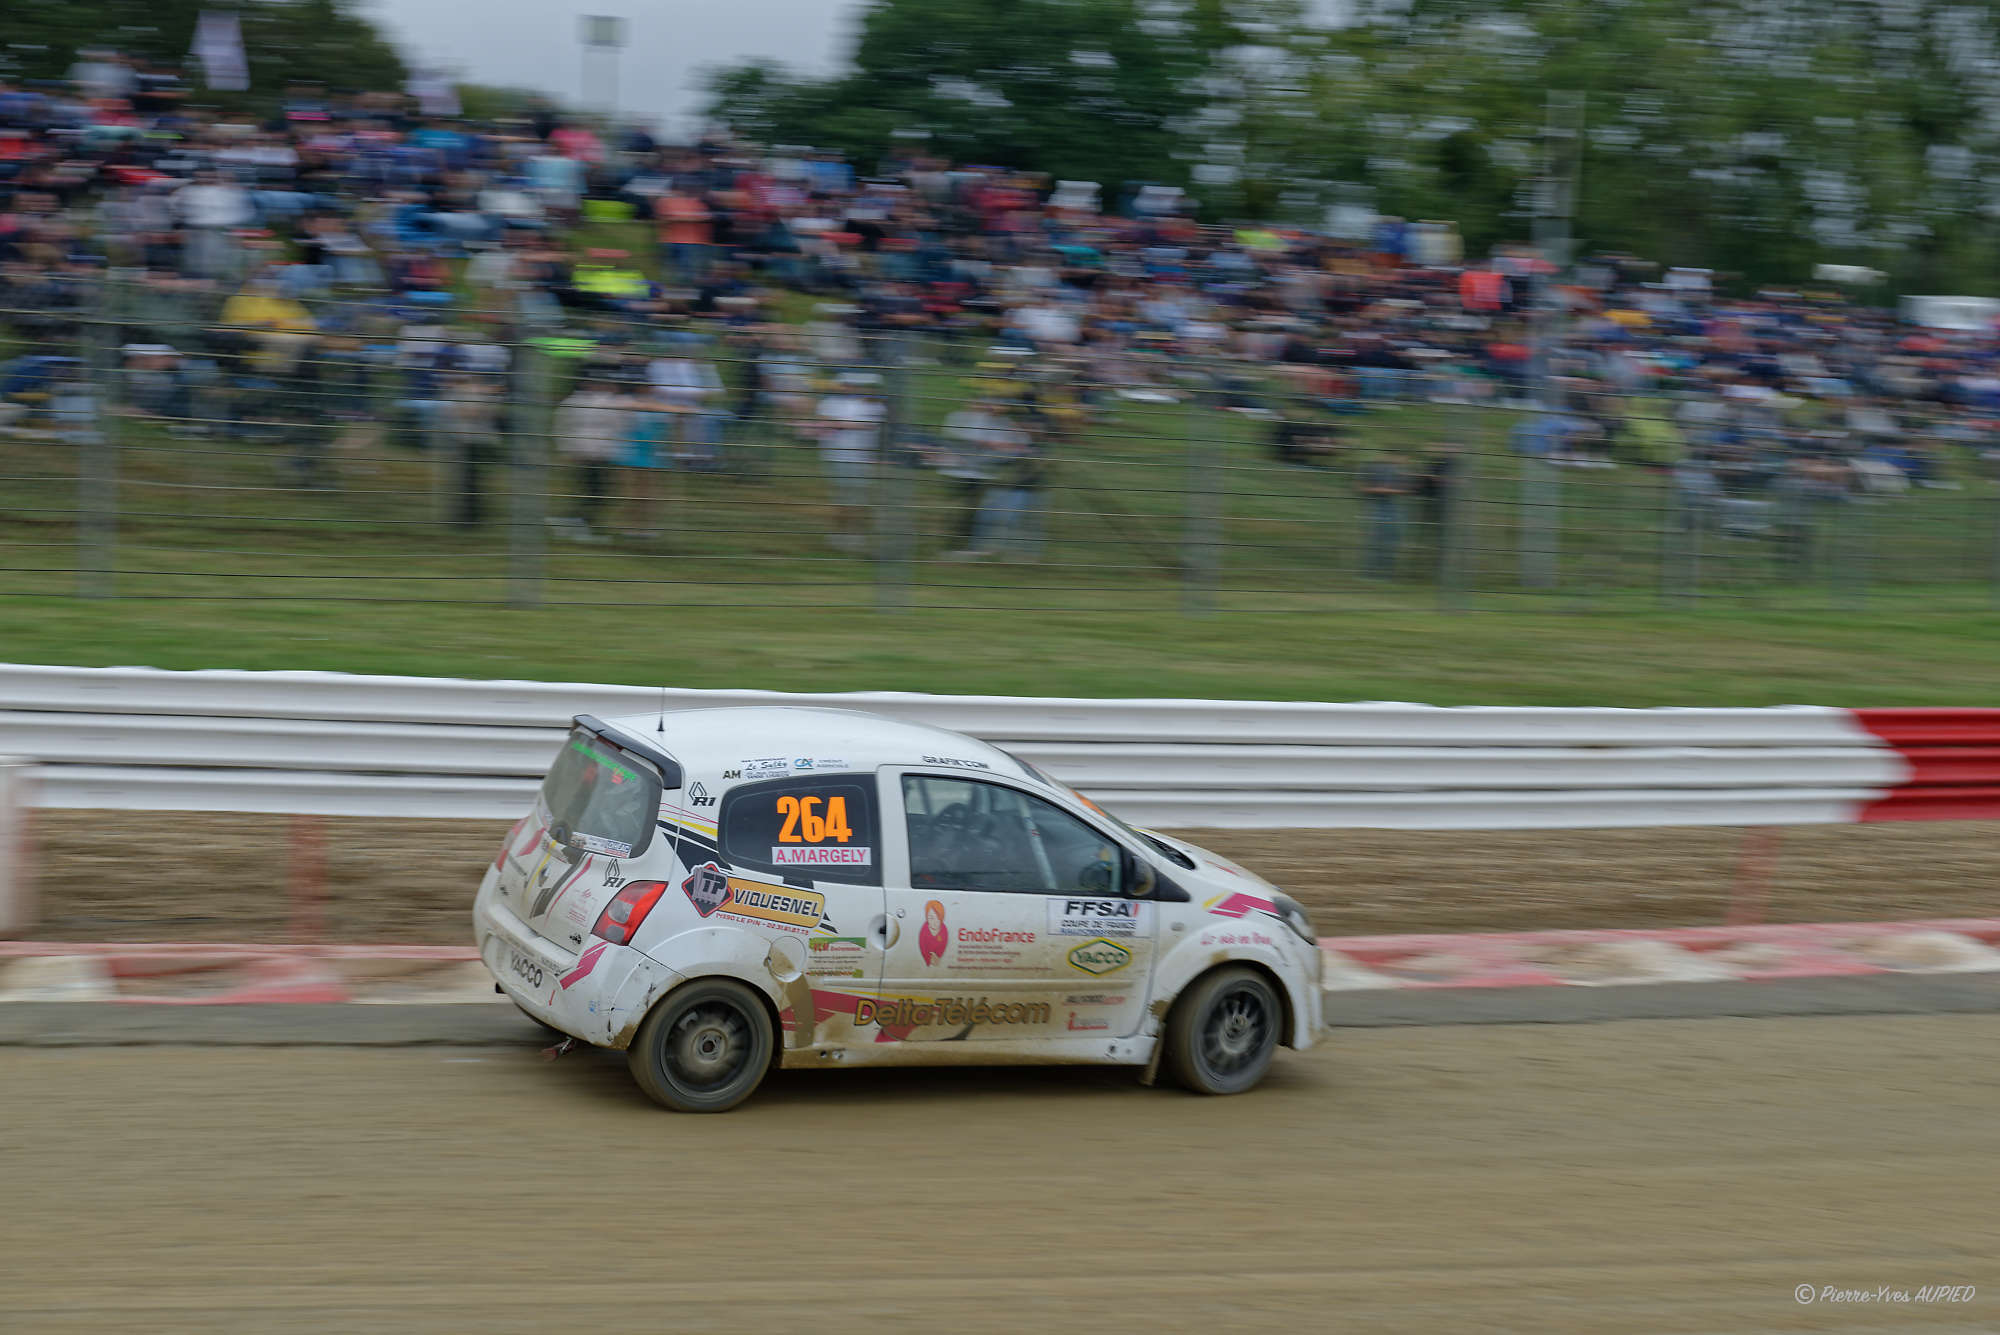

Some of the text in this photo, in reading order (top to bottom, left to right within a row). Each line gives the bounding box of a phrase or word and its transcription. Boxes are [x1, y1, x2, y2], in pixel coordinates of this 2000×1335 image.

[722, 769, 742, 780] AM
[692, 796, 717, 807] R1
[776, 796, 853, 843] 264
[775, 849, 867, 863] A.MARGELY
[702, 871, 728, 895] TP
[734, 888, 820, 917] VIQUESNEL
[1065, 901, 1130, 917] FFSA
[746, 919, 761, 927] PIN
[958, 927, 1036, 943] EndoFrance
[1072, 950, 1126, 964] YACCO
